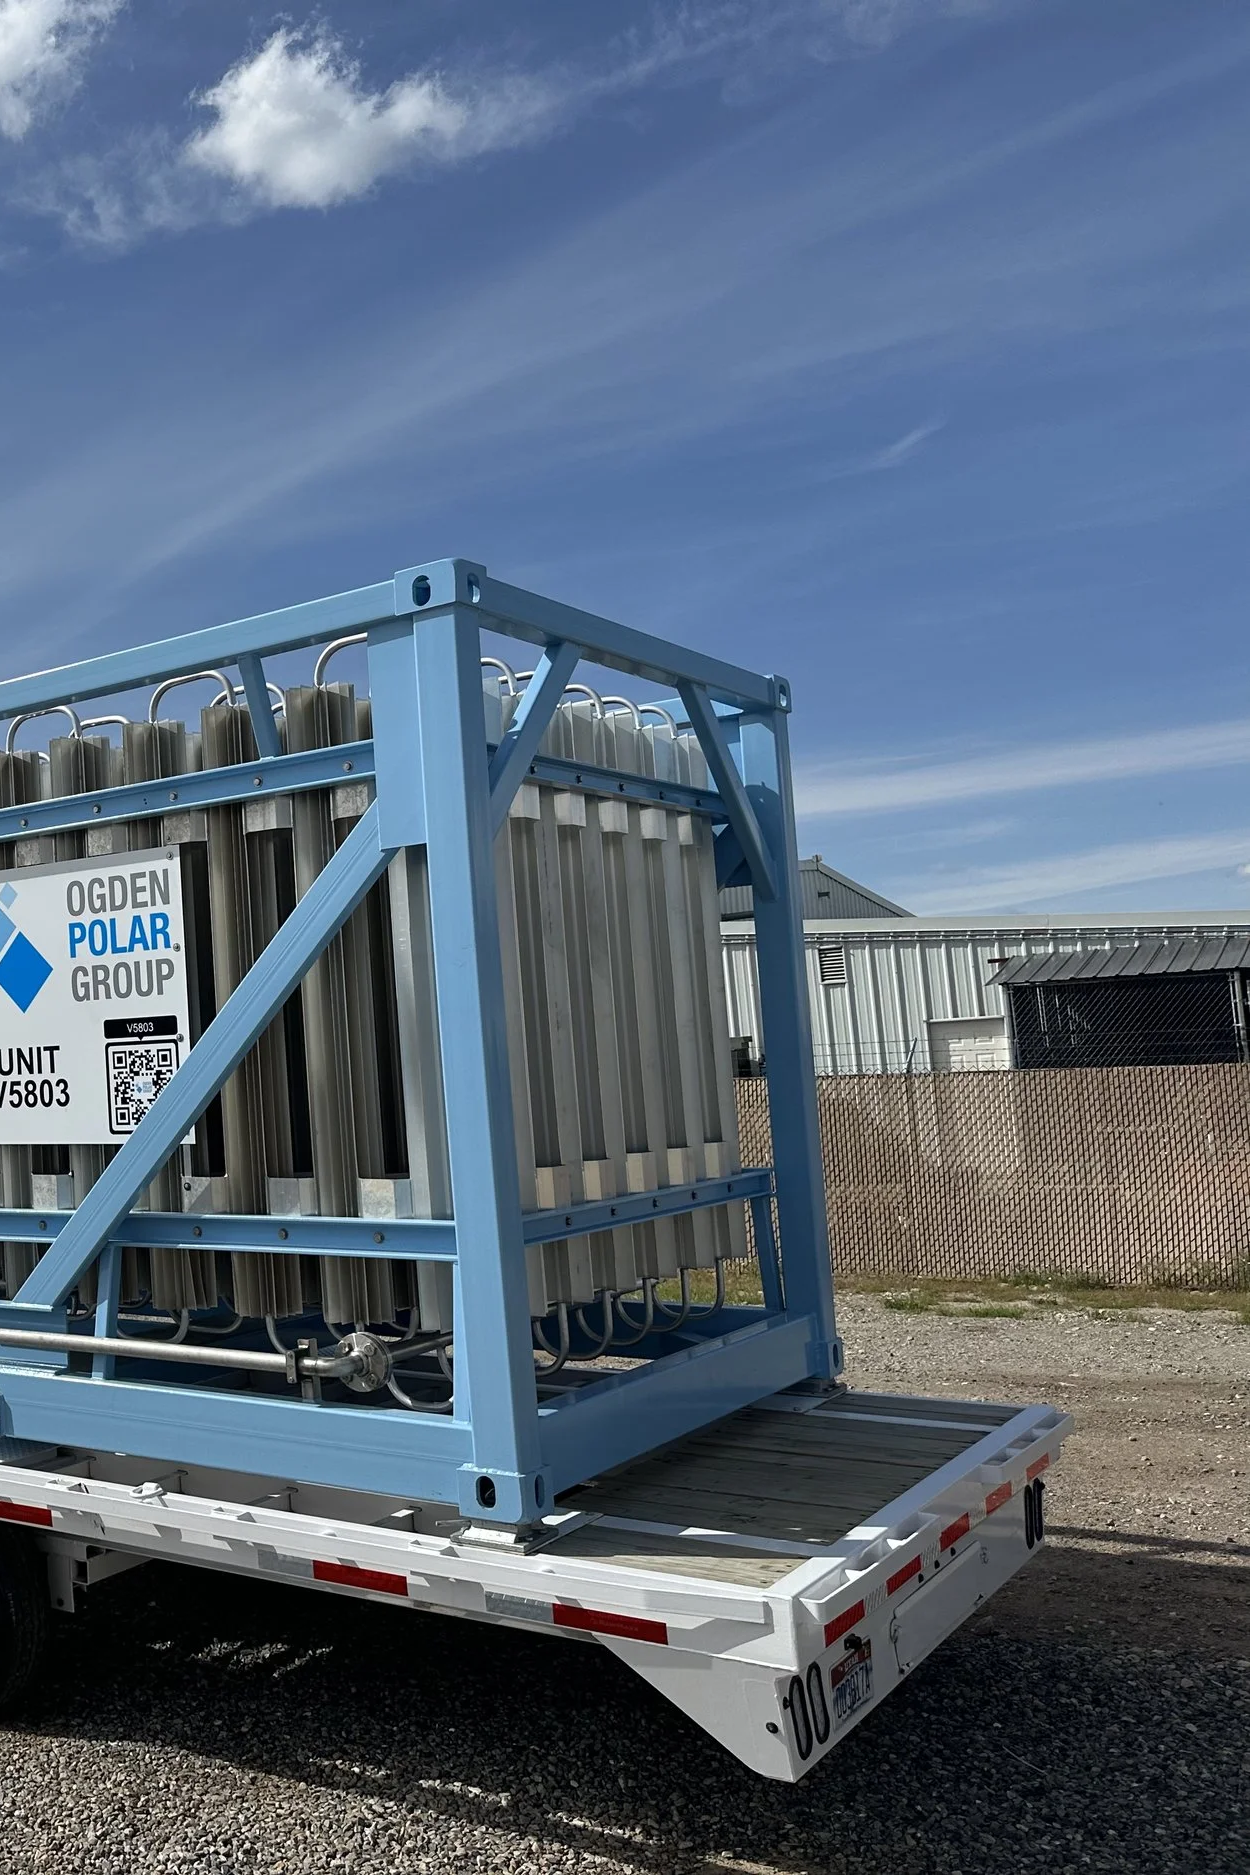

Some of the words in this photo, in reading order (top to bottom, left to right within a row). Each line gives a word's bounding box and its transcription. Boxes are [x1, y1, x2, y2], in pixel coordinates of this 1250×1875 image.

[66, 868, 171, 917] OGDEN
[68, 912, 171, 959] POLAR
[71, 958, 175, 1002] GROUP
[126, 1022, 154, 1033] V5803
[844, 1652, 859, 1673] UTAH
